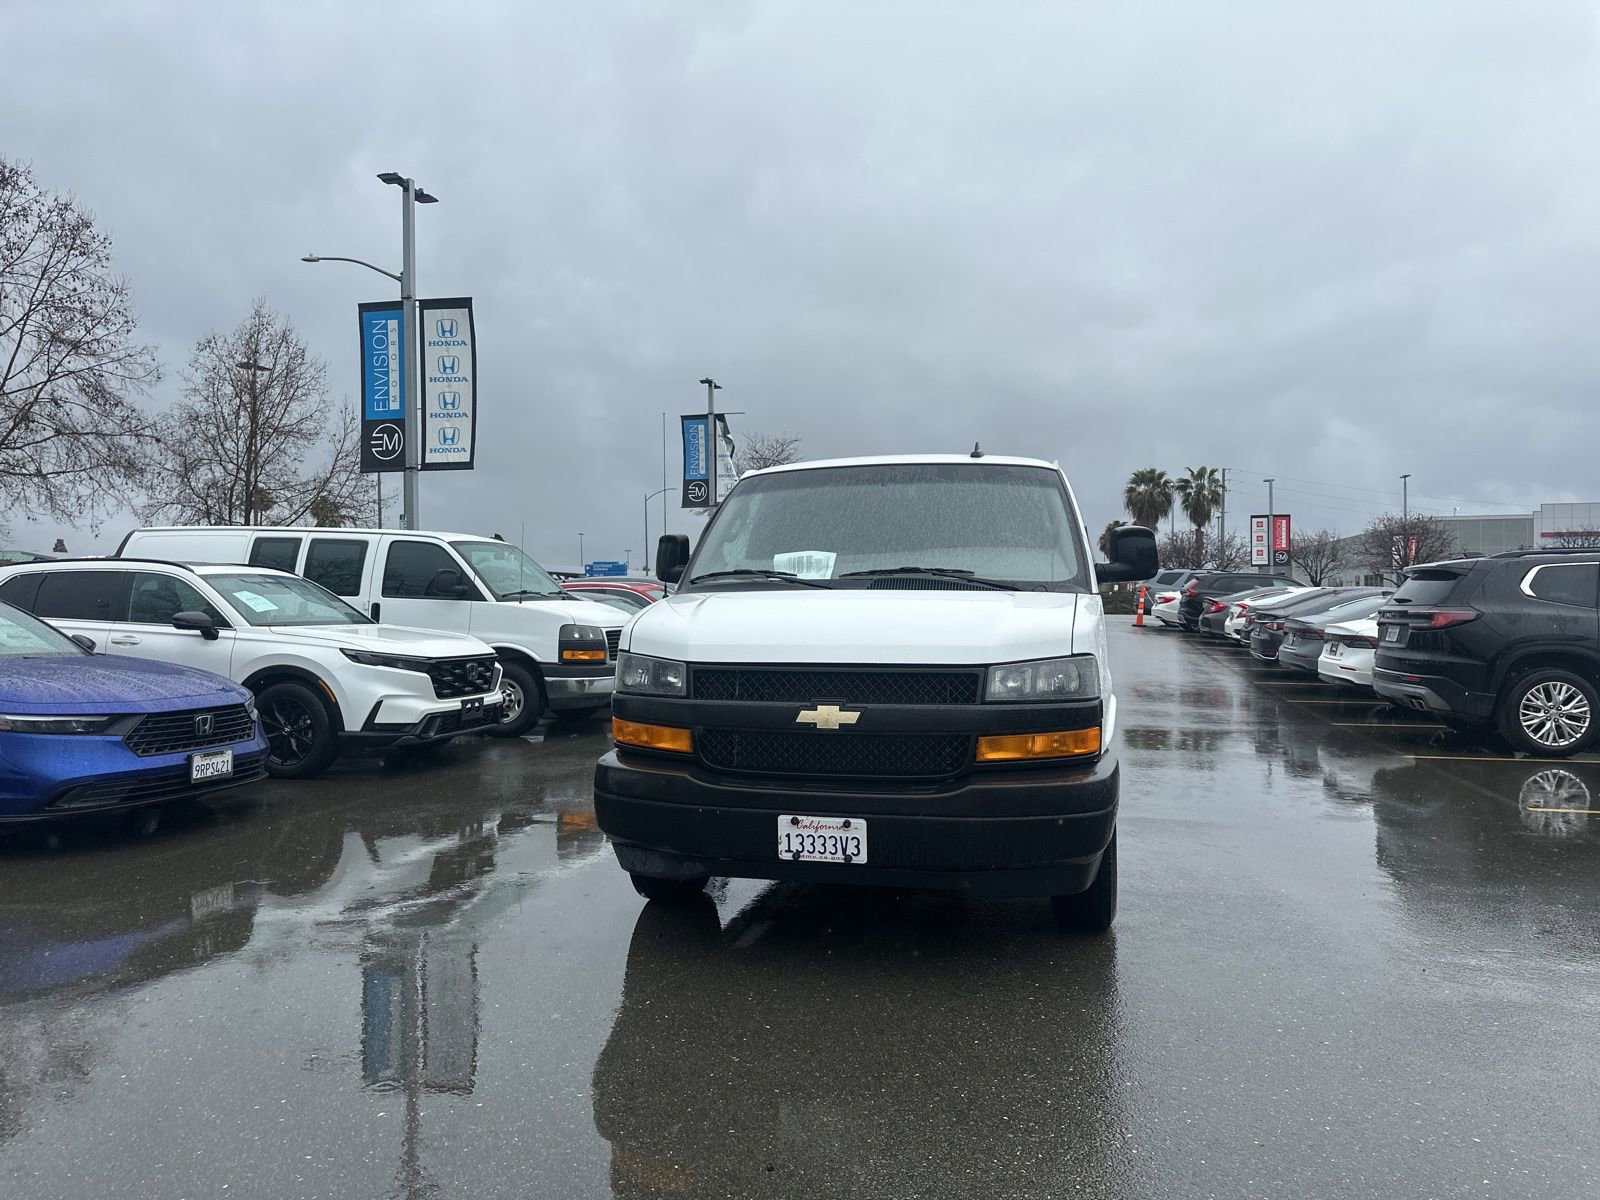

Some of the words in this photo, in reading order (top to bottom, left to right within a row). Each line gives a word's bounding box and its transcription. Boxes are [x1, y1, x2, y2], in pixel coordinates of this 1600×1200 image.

[372, 319, 389, 412] ENVISION
[689, 424, 699, 476] ENVISION
[194, 760, 230, 778] 9RPS421
[796, 819, 845, 833] California
[784, 832, 861, 857] 13333V3
